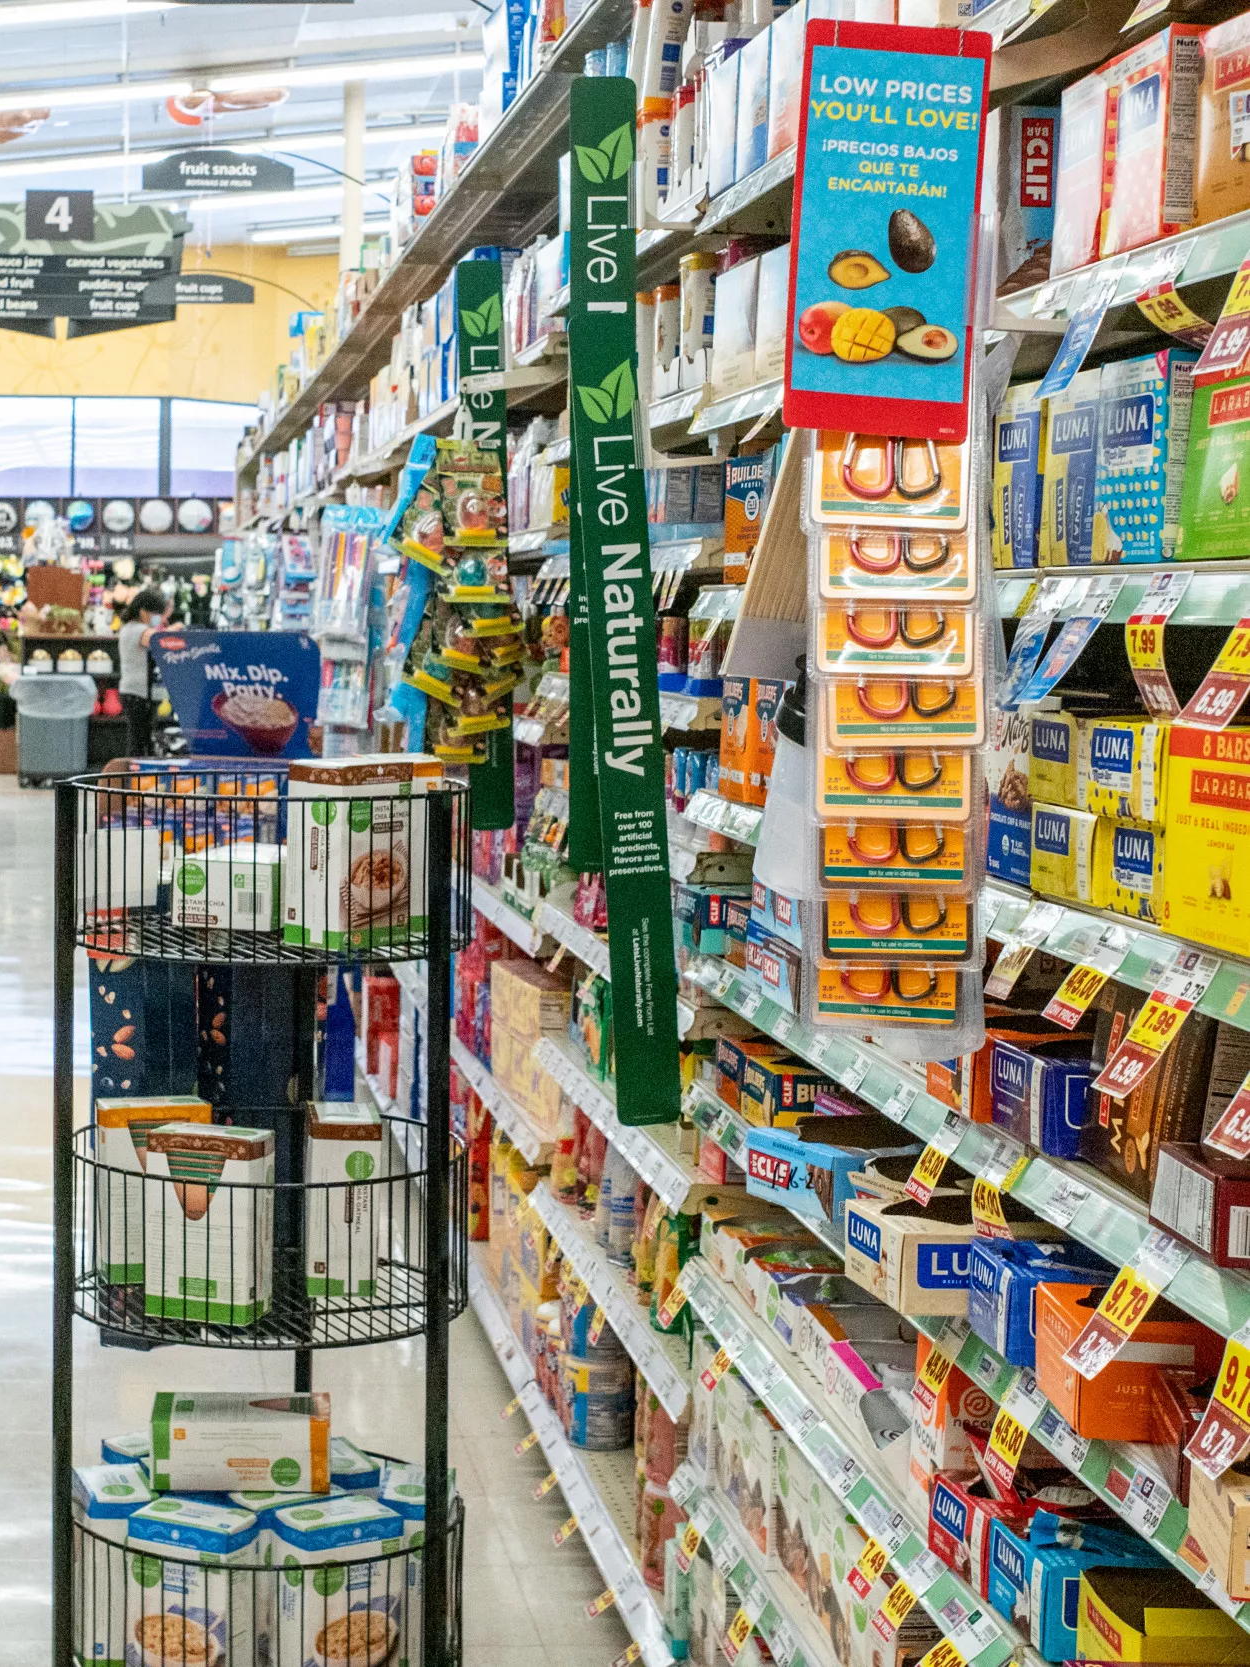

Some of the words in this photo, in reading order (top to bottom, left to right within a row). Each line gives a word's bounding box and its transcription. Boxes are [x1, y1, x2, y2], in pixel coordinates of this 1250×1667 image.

[820, 74, 879, 97] LOW
[885, 80, 973, 104] PRICES
[811, 100, 898, 125] YOU'LL
[906, 107, 978, 131] LOVE!
[822, 139, 899, 157] ¡PRECIOS
[903, 145, 959, 162] BAJOS
[179, 161, 210, 175] fruit
[212, 162, 257, 176] snacks
[859, 160, 895, 175] QUE
[899, 164, 919, 177] TE
[1025, 138, 1049, 202] CLIF
[828, 176, 948, 198] ENCANTARÁN!
[45, 196, 73, 232] 4
[587, 195, 629, 284] Live
[24, 257, 44, 268] jars
[66, 257, 105, 268] canned
[107, 257, 164, 269] vegetables
[10, 277, 34, 288] fruit
[79, 279, 123, 292] pudding
[175, 282, 198, 293] fruit
[200, 284, 223, 294] cups
[6, 299, 38, 309] beans
[89, 299, 113, 310] fruit
[115, 302, 140, 312] cups
[1210, 325, 1248, 359] 6.99
[1055, 414, 1090, 444] LUNA
[1106, 403, 1150, 435] LUNA
[1000, 426, 1029, 451] LUNA
[593, 435, 634, 527] Live
[1130, 629, 1156, 654] 7.99
[205, 662, 248, 681] Mix.
[248, 664, 289, 684] Dip.
[600, 542, 654, 778] Naturally
[222, 681, 283, 702] Party.
[1195, 687, 1236, 715] 6.99
[1035, 726, 1066, 752] LUNA
[1095, 735, 1130, 761] LUNA
[1203, 734, 1212, 757] 8
[1216, 735, 1250, 761] BARS
[614, 812, 633, 821] Free
[634, 810, 654, 819] from
[618, 822, 636, 831] over
[638, 820, 653, 829] 100
[1176, 813, 1192, 825] JUST
[1201, 817, 1219, 831] REAL
[619, 832, 652, 842] artificial
[1038, 820, 1067, 845] LUNA
[612, 843, 661, 855] ingredients,
[614, 854, 642, 864] flavors
[644, 853, 660, 862] and
[1117, 834, 1151, 862] LUNA
[609, 865, 666, 877] preservatives.
[632, 928, 639, 936] at
[642, 947, 651, 982] complete
[632, 937, 644, 1028] LetsLiveNaturally.com
[645, 983, 653, 1000] Free
[1065, 969, 1103, 1000] 4/5.00
[1180, 980, 1205, 1001] 9.79
[1142, 1006, 1177, 1036] 7.99
[998, 1057, 1023, 1086] LUNA
[1109, 1055, 1144, 1086] 6.99
[783, 1081, 792, 1106] CLIF
[758, 1156, 788, 1185] CLIF
[920, 1147, 946, 1180] 4/5.00
[906, 1180, 917, 1194] LOW
[916, 1185, 931, 1204] PRICE
[973, 1182, 1002, 1218] 4/5.00
[851, 1217, 878, 1252] LUNA
[974, 1258, 993, 1289] LUNA
[1106, 1278, 1150, 1326] 9.79
[926, 1350, 950, 1386] 4/5.00
[1114, 1384, 1147, 1396] JUST
[995, 1414, 1024, 1457] 4/5.00
[1201, 1420, 1236, 1457] 8.79
[985, 1450, 996, 1469] LOW
[995, 1459, 1013, 1483] PRICE
[936, 1492, 964, 1530] LUNA
[862, 1541, 886, 1574] 7.49
[997, 1537, 1023, 1582] LUNA
[888, 1583, 915, 1619] 4/5.00
